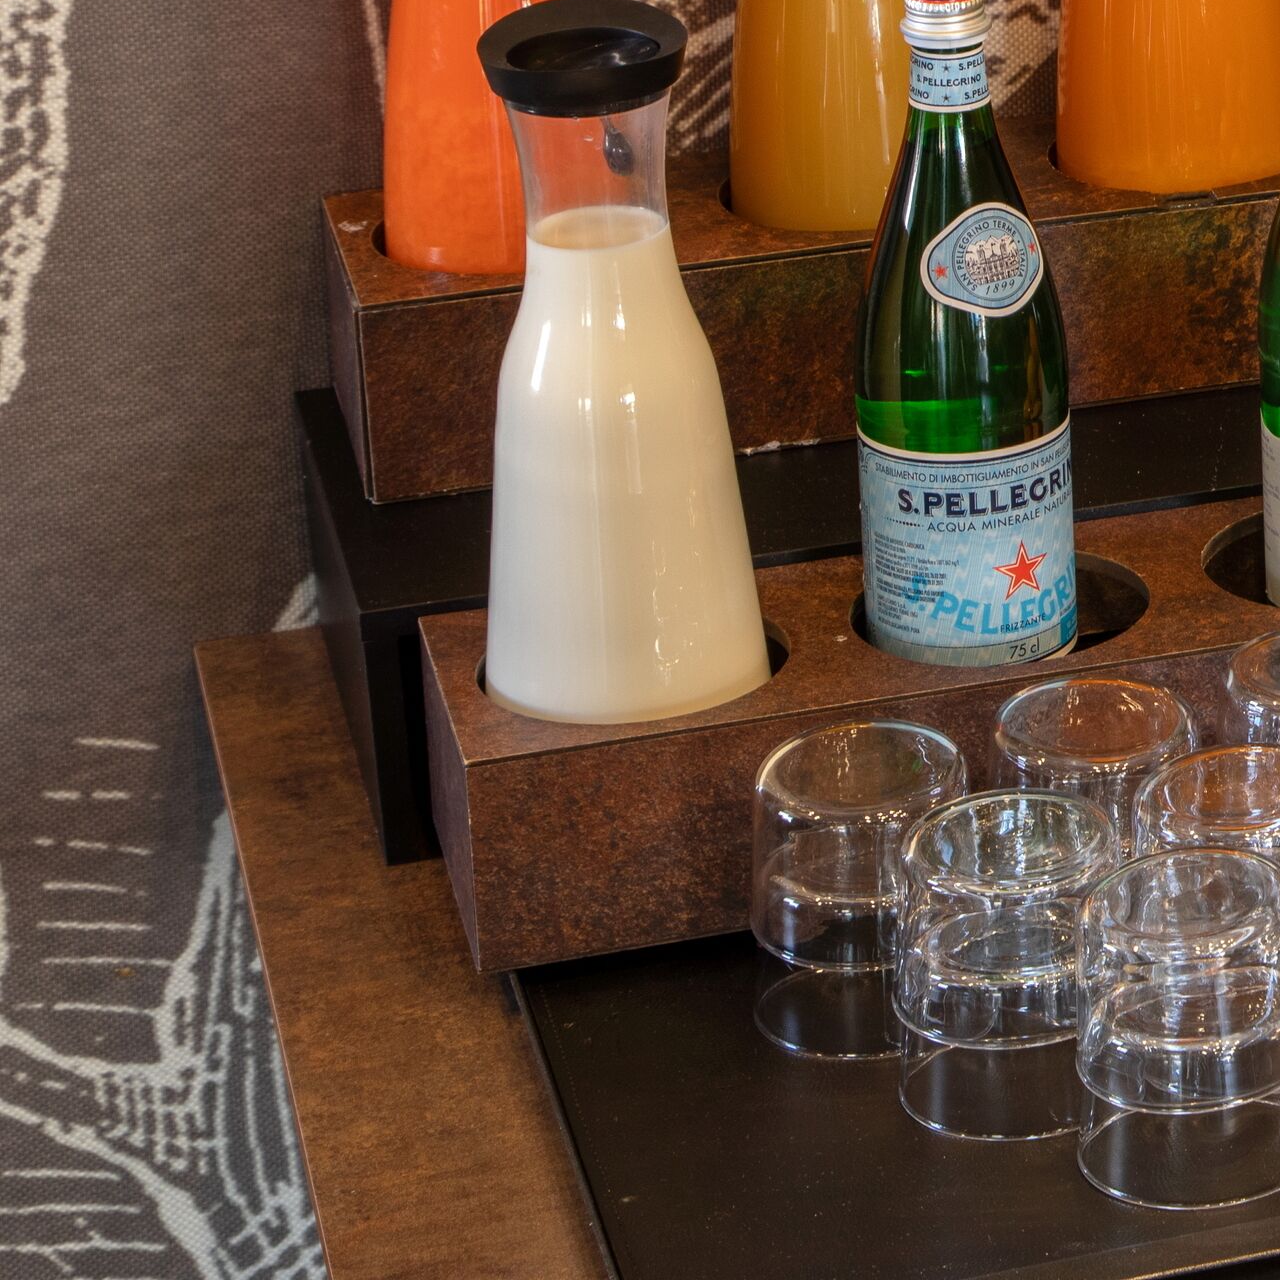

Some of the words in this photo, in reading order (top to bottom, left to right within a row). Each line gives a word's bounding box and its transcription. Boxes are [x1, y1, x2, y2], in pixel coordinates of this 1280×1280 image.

[916, 73, 982, 88] S.PELLEGRINO
[993, 220, 1017, 237] TERME
[956, 221, 990, 271] PELLEGRINO
[961, 274, 978, 291] SAN
[985, 279, 1015, 296] 1899
[875, 462, 927, 483] STABILIMENTO
[929, 474, 938, 483] DI
[941, 463, 1029, 483] IMBOTTIGLIAMENTO
[1030, 461, 1039, 471] IN
[1041, 454, 1054, 466] SAN
[927, 521, 977, 533] ACQUA
[981, 507, 1040, 530] MINERALE
[1000, 613, 1046, 633] FRIZZANTE
[1010, 642, 1027, 660] 75
